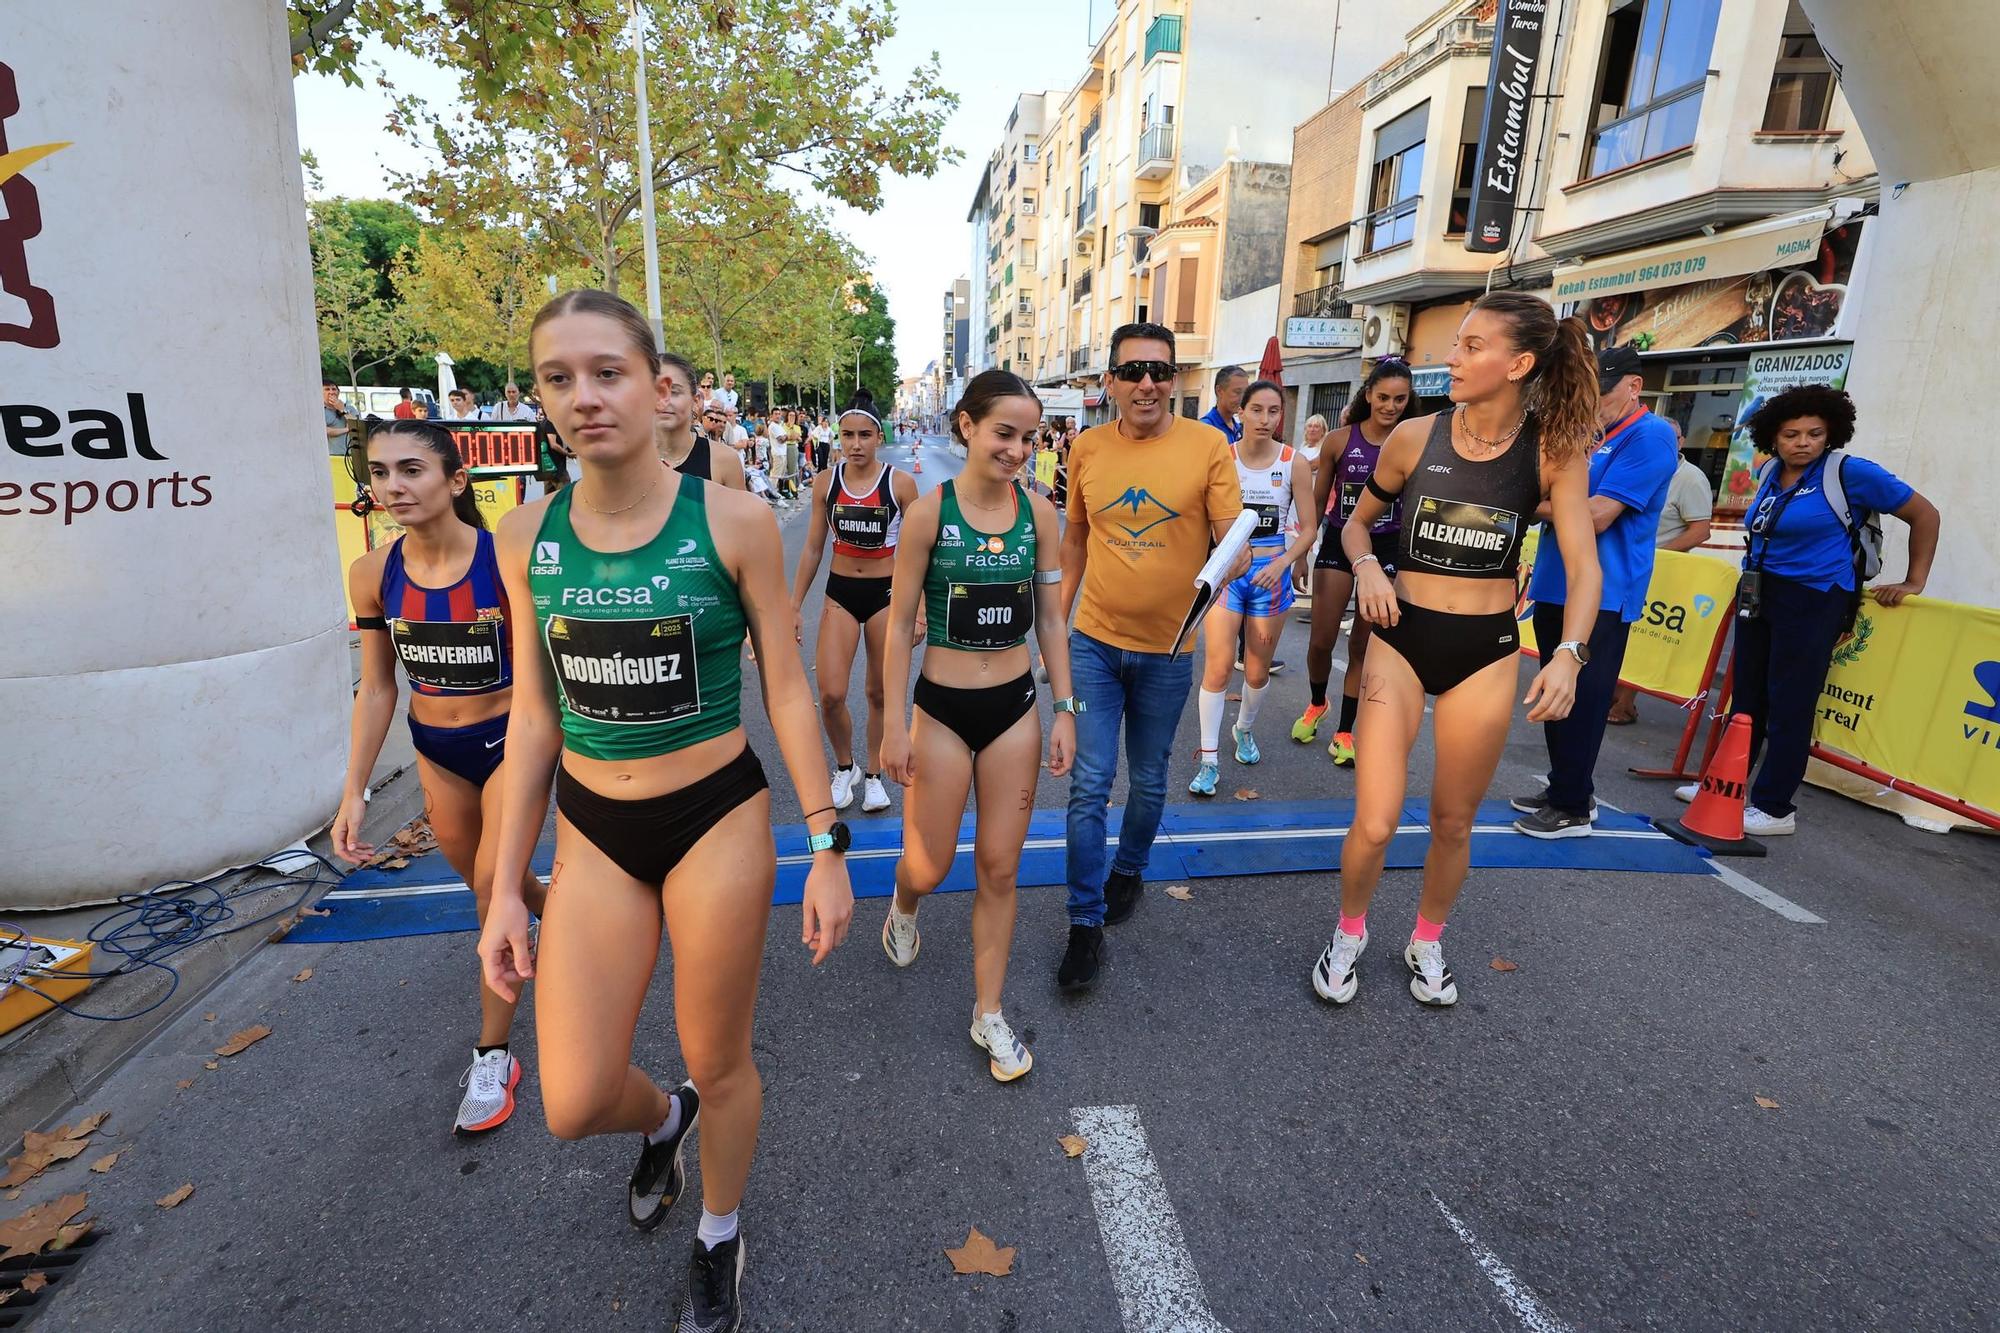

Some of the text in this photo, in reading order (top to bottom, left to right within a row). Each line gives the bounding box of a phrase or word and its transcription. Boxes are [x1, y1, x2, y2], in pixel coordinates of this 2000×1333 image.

[1511, 15, 1539, 30] Turca
[1487, 44, 1534, 194] Estambul
[1776, 238, 1811, 255] MAGNA
[1558, 256, 1706, 296] Kebab Estambul 964 073 079
[1754, 353, 1844, 373] GRANIZADOS
[0, 392, 170, 461] eal
[451, 431, 536, 469] 0:00:00
[838, 519, 882, 533] CARVAJAL
[1418, 521, 1507, 551] ALEXANDRE
[1107, 539, 1167, 548] FUJITRAIL
[561, 586, 654, 606] Facsa
[977, 606, 1012, 625] SOTO
[467, 625, 475, 635] 4
[650, 623, 681, 637] 4 2025
[1630, 624, 1648, 634] gral
[399, 643, 495, 665] ECHEVERRIA
[560, 651, 682, 685] RODRÍGUEZ
[1822, 682, 1875, 711] ment
[1814, 706, 1861, 732] -real
